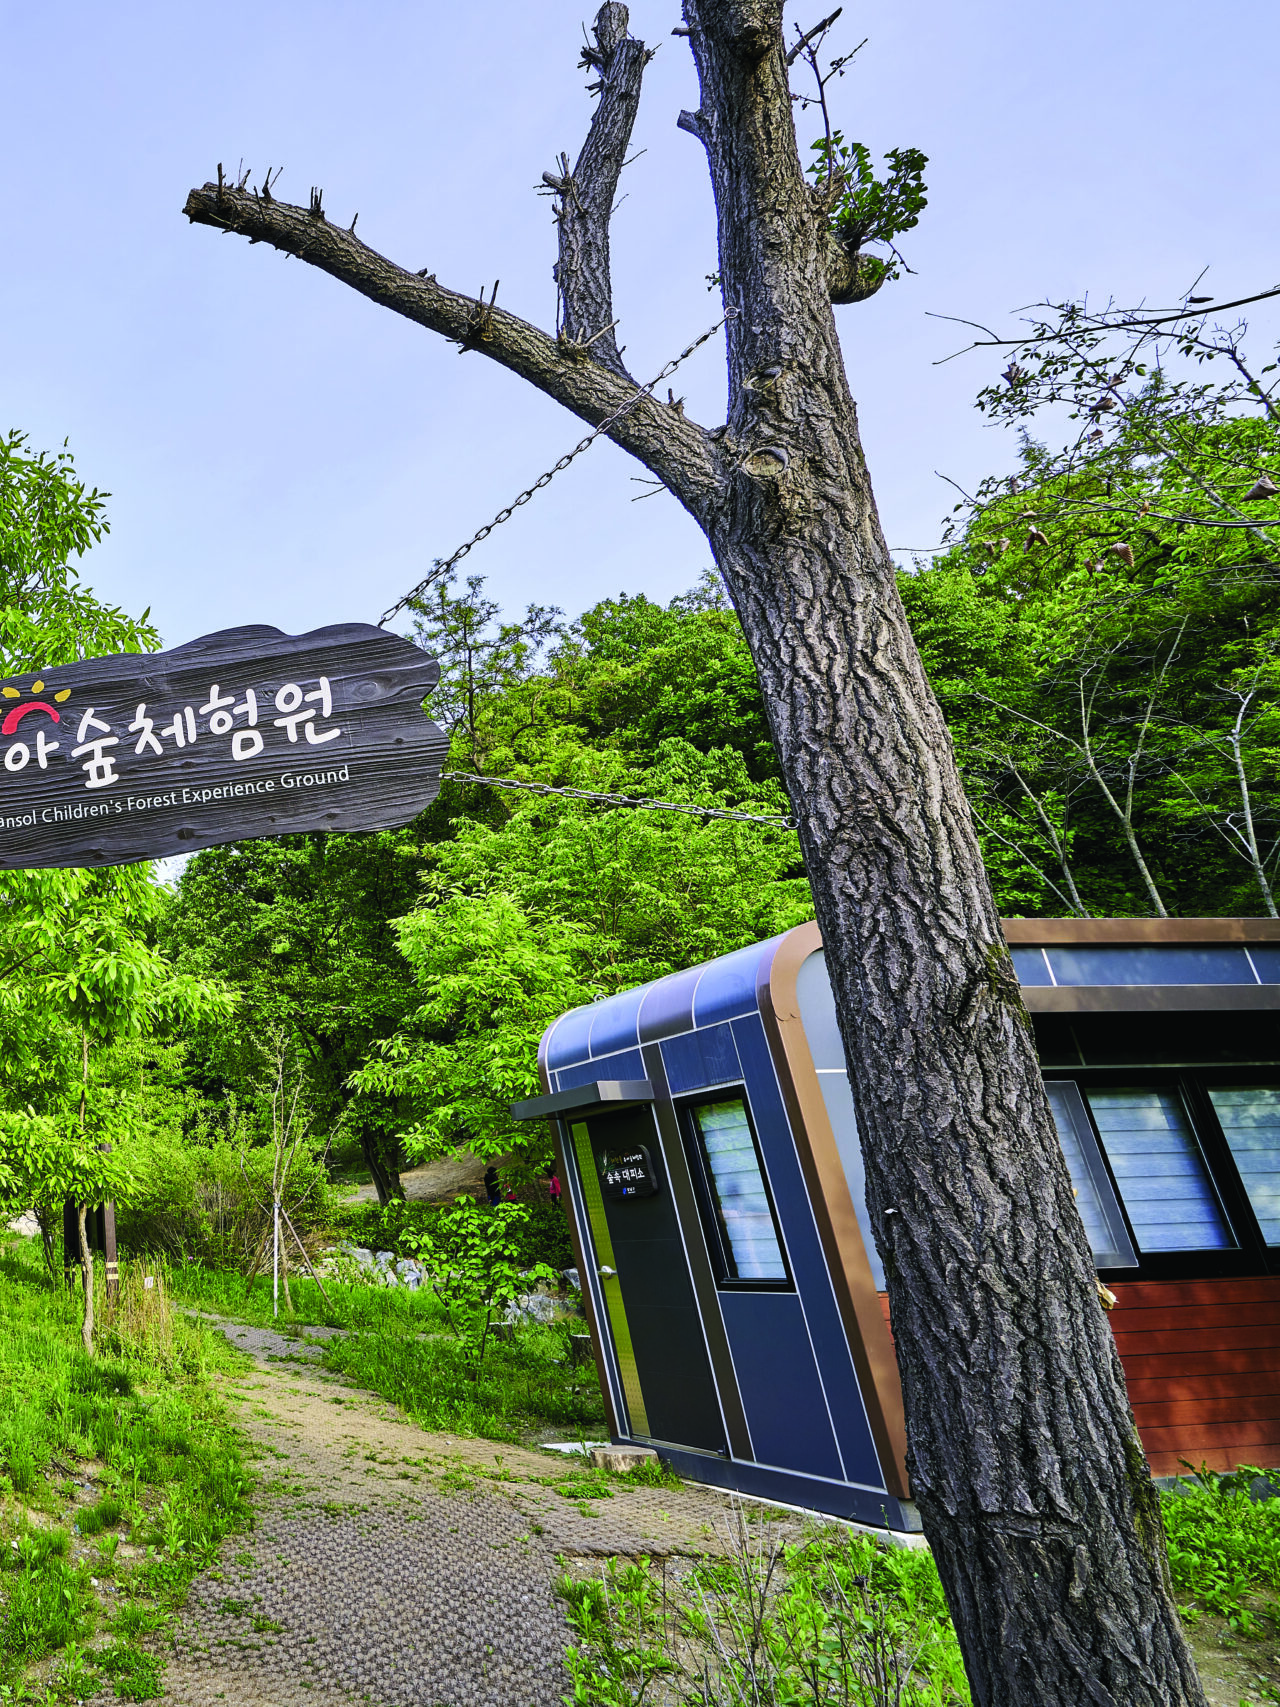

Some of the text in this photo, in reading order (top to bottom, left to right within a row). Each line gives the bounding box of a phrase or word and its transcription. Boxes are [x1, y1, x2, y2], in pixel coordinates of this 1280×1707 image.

[41, 800, 123, 824] Children's
[127, 791, 177, 811] Forest
[182, 778, 275, 804] Experience
[280, 765, 350, 788] Ground
[622, 1168, 645, 1181] 대피소
